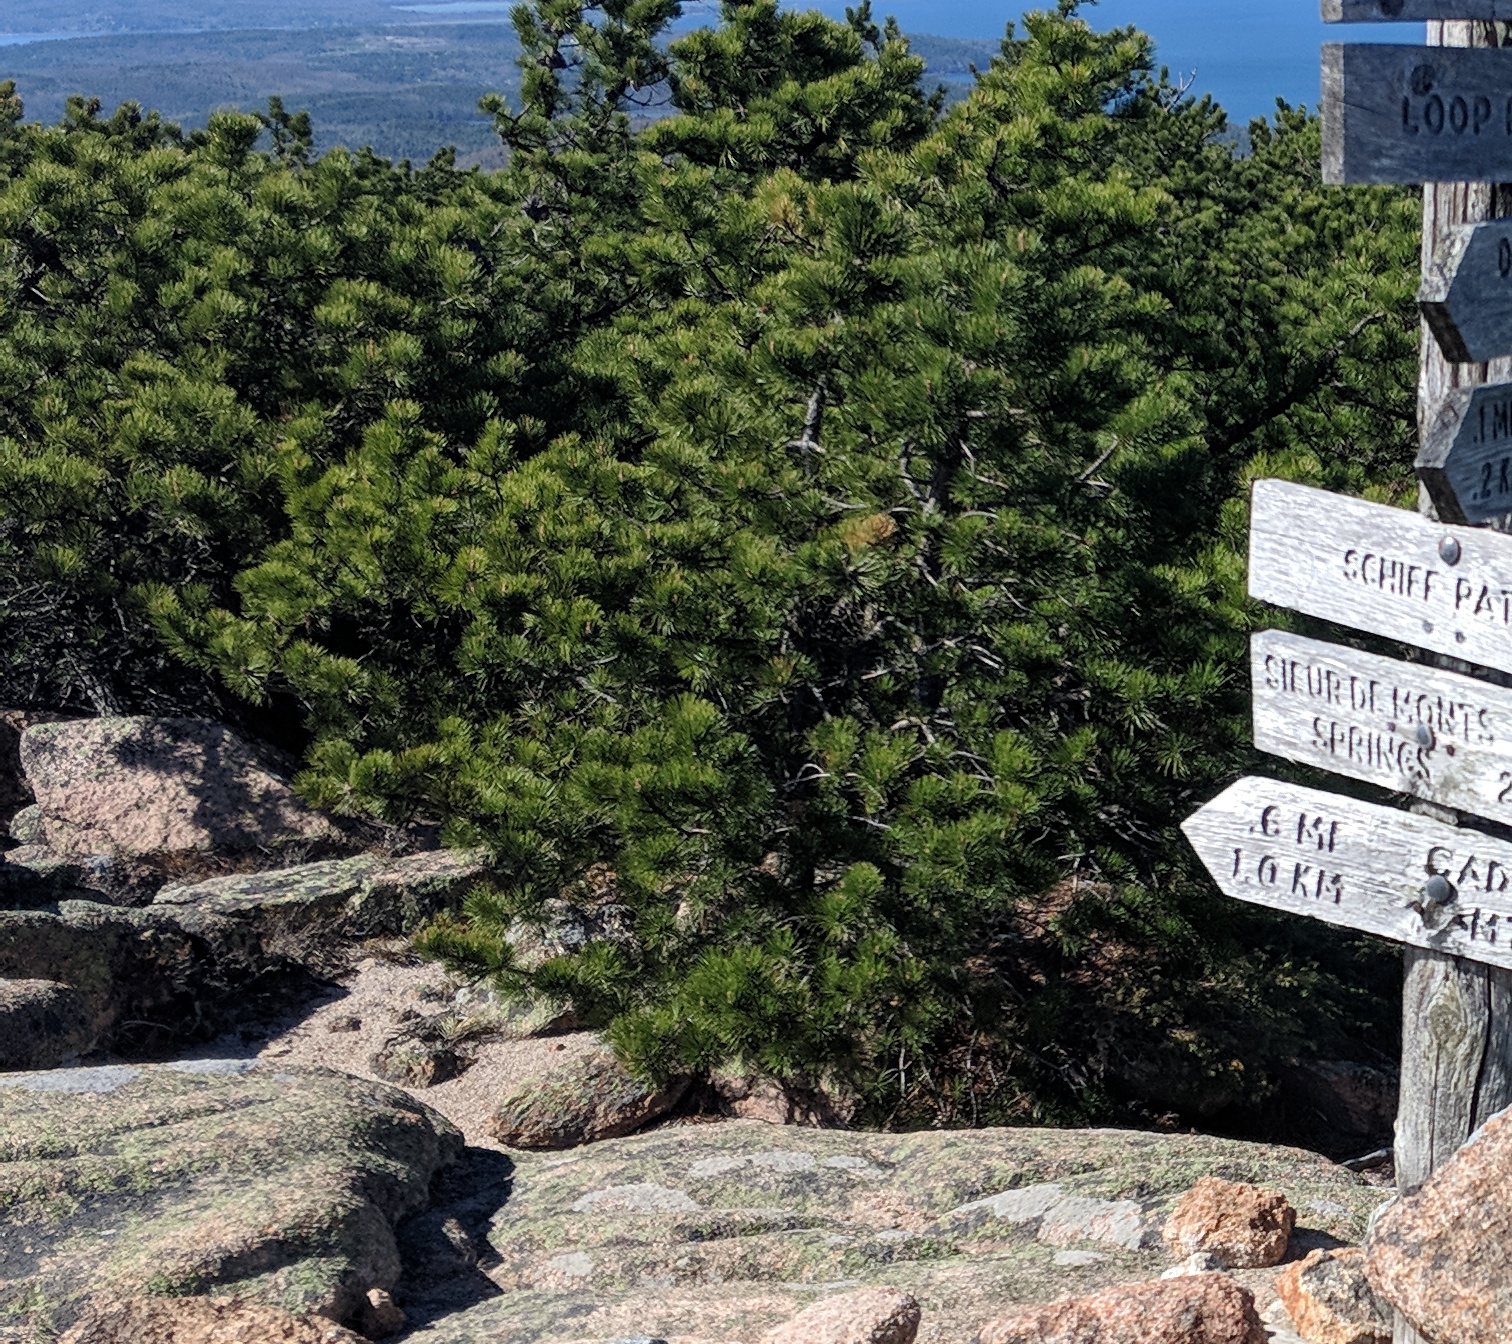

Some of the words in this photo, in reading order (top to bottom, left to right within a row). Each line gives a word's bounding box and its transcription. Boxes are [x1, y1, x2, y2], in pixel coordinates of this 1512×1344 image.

[1402, 94, 1492, 136] LOOP
[1473, 462, 1493, 500] .2
[1343, 549, 1439, 601] SCHIFF
[1265, 654, 1341, 705] SIEUR
[1350, 675, 1382, 713] DE
[1393, 687, 1495, 742] MONTS
[1312, 716, 1431, 780] SPRINGS
[1297, 813, 1338, 853] MI
[1233, 847, 1277, 887] 1.0
[1291, 862, 1343, 905] KM
